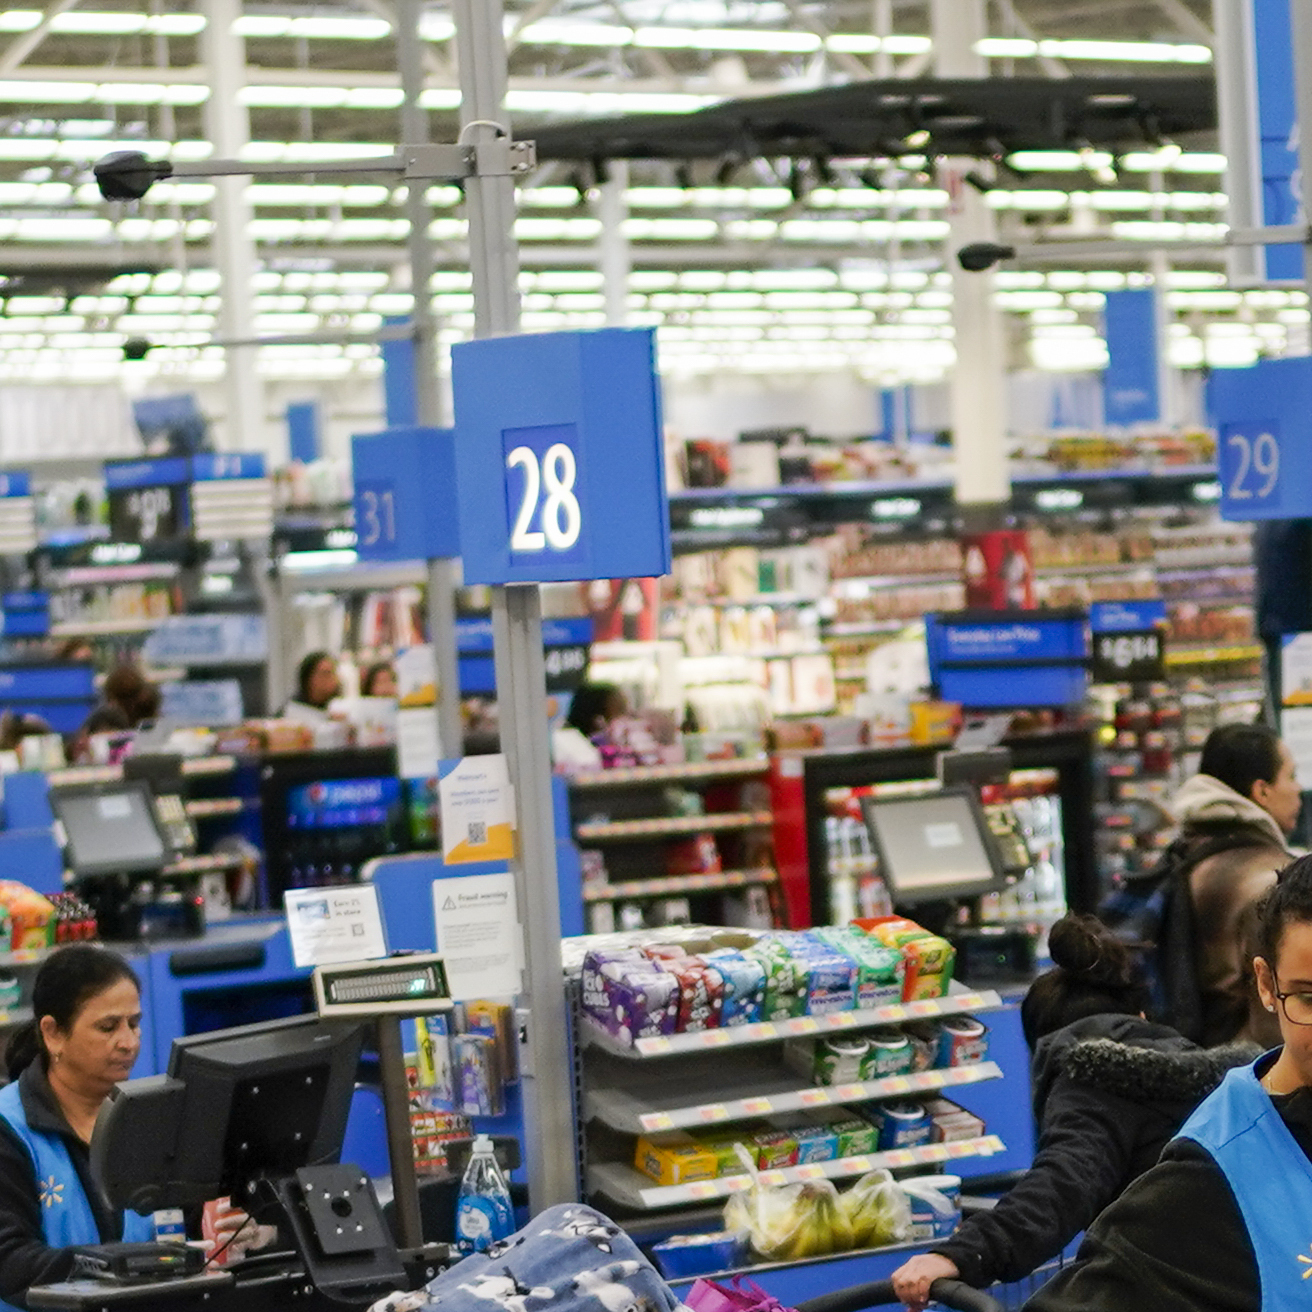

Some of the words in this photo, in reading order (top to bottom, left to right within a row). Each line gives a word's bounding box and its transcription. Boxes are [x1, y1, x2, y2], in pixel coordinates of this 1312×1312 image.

[506, 442, 582, 550] 28
[1228, 432, 1280, 499] 29
[363, 490, 396, 546] 31
